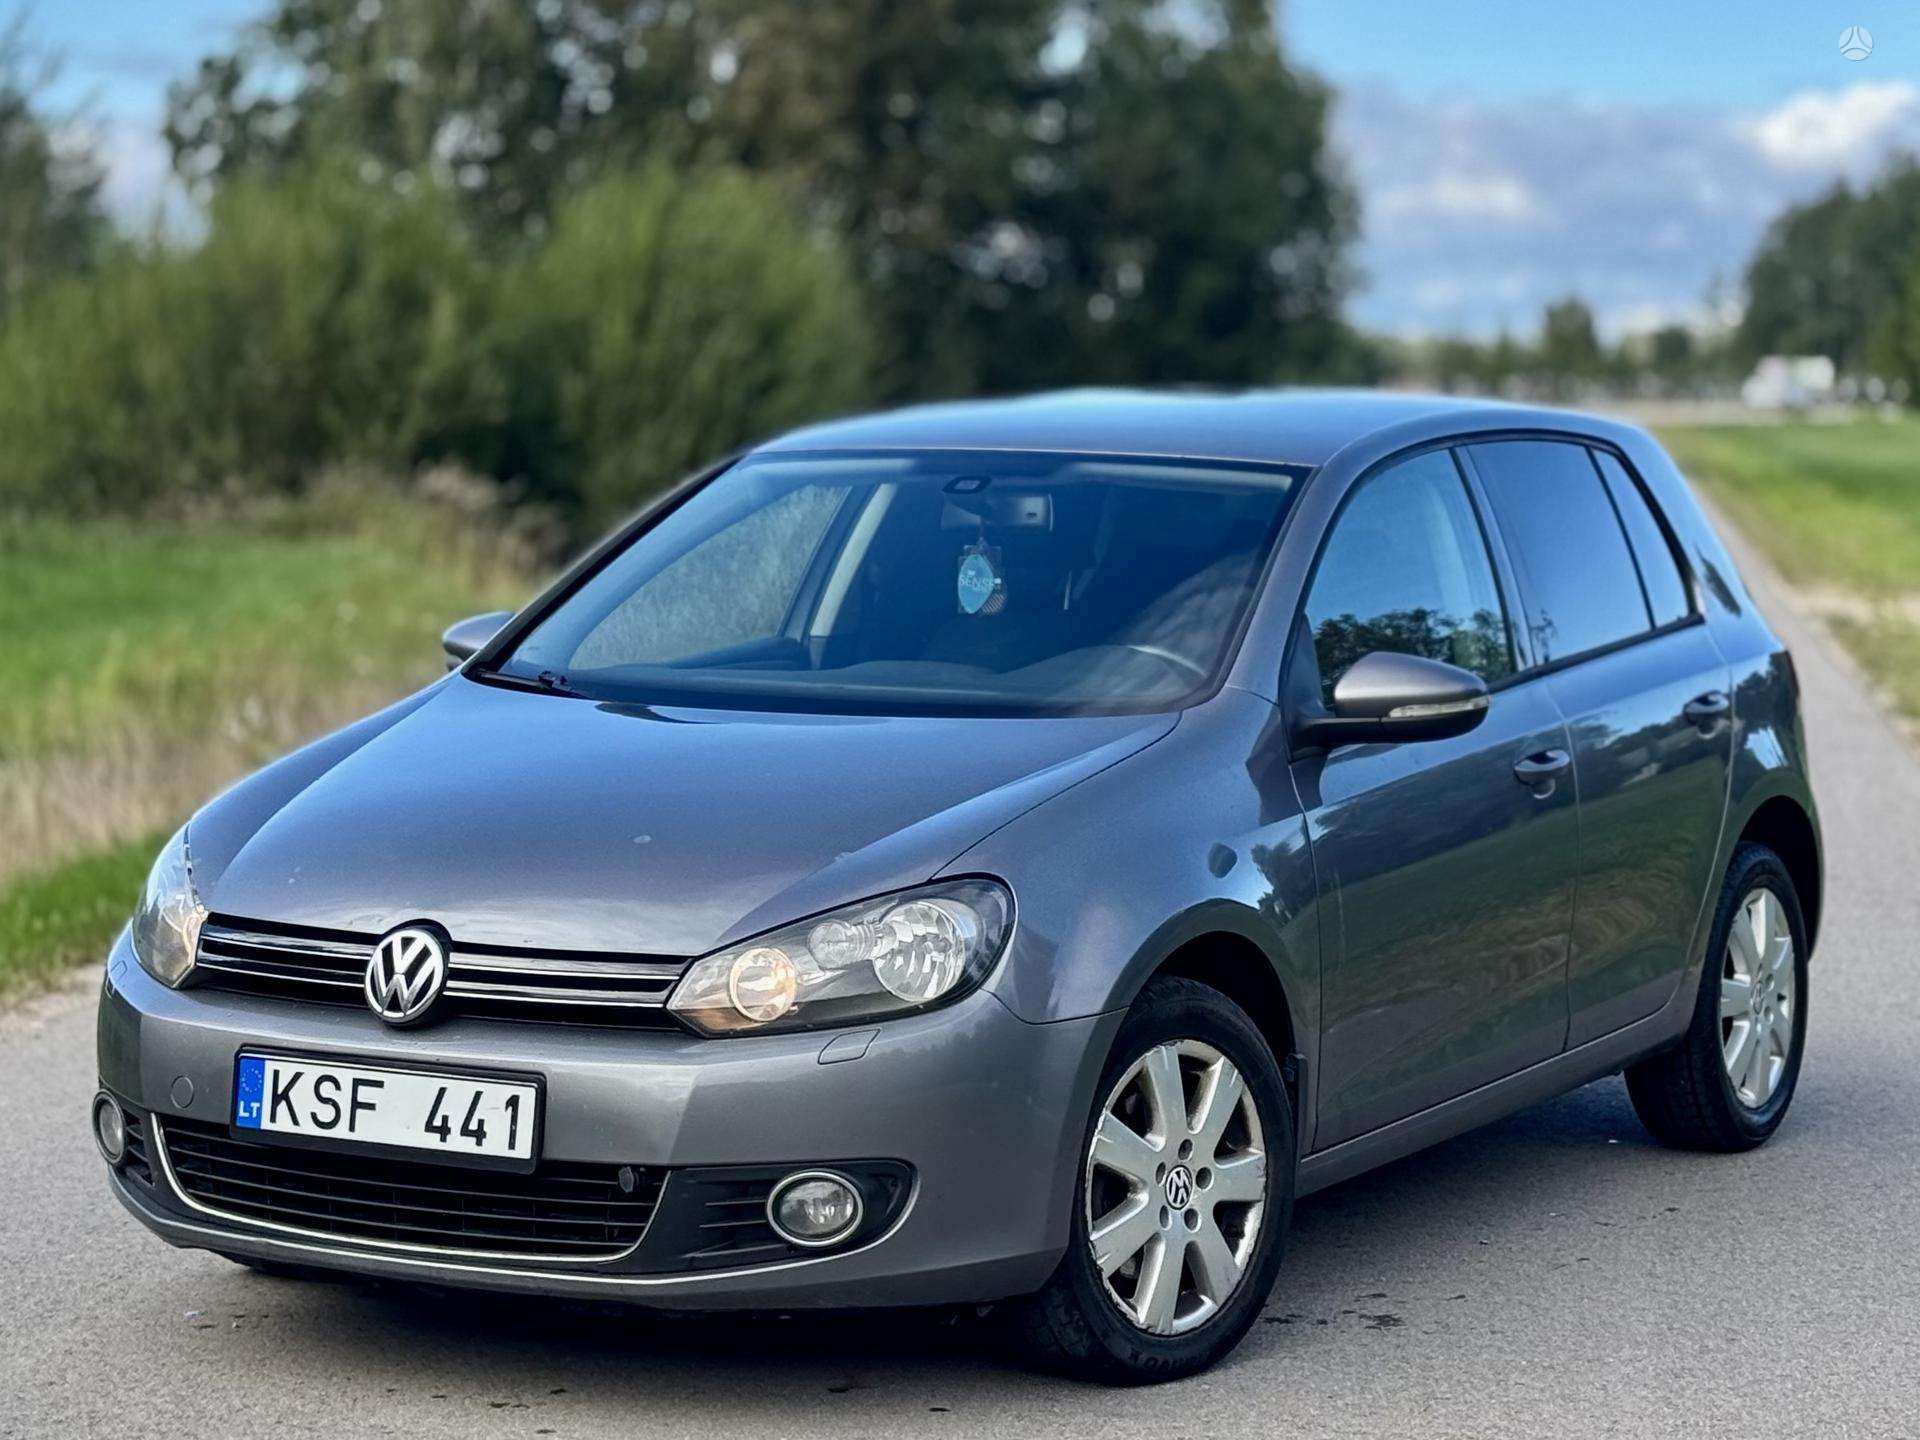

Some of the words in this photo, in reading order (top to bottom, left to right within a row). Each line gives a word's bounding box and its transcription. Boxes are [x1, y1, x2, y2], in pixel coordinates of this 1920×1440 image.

[366, 930, 443, 1018] VW
[239, 1101, 260, 1118] LT
[269, 1069, 385, 1133] KSF
[424, 1086, 521, 1150] 441
